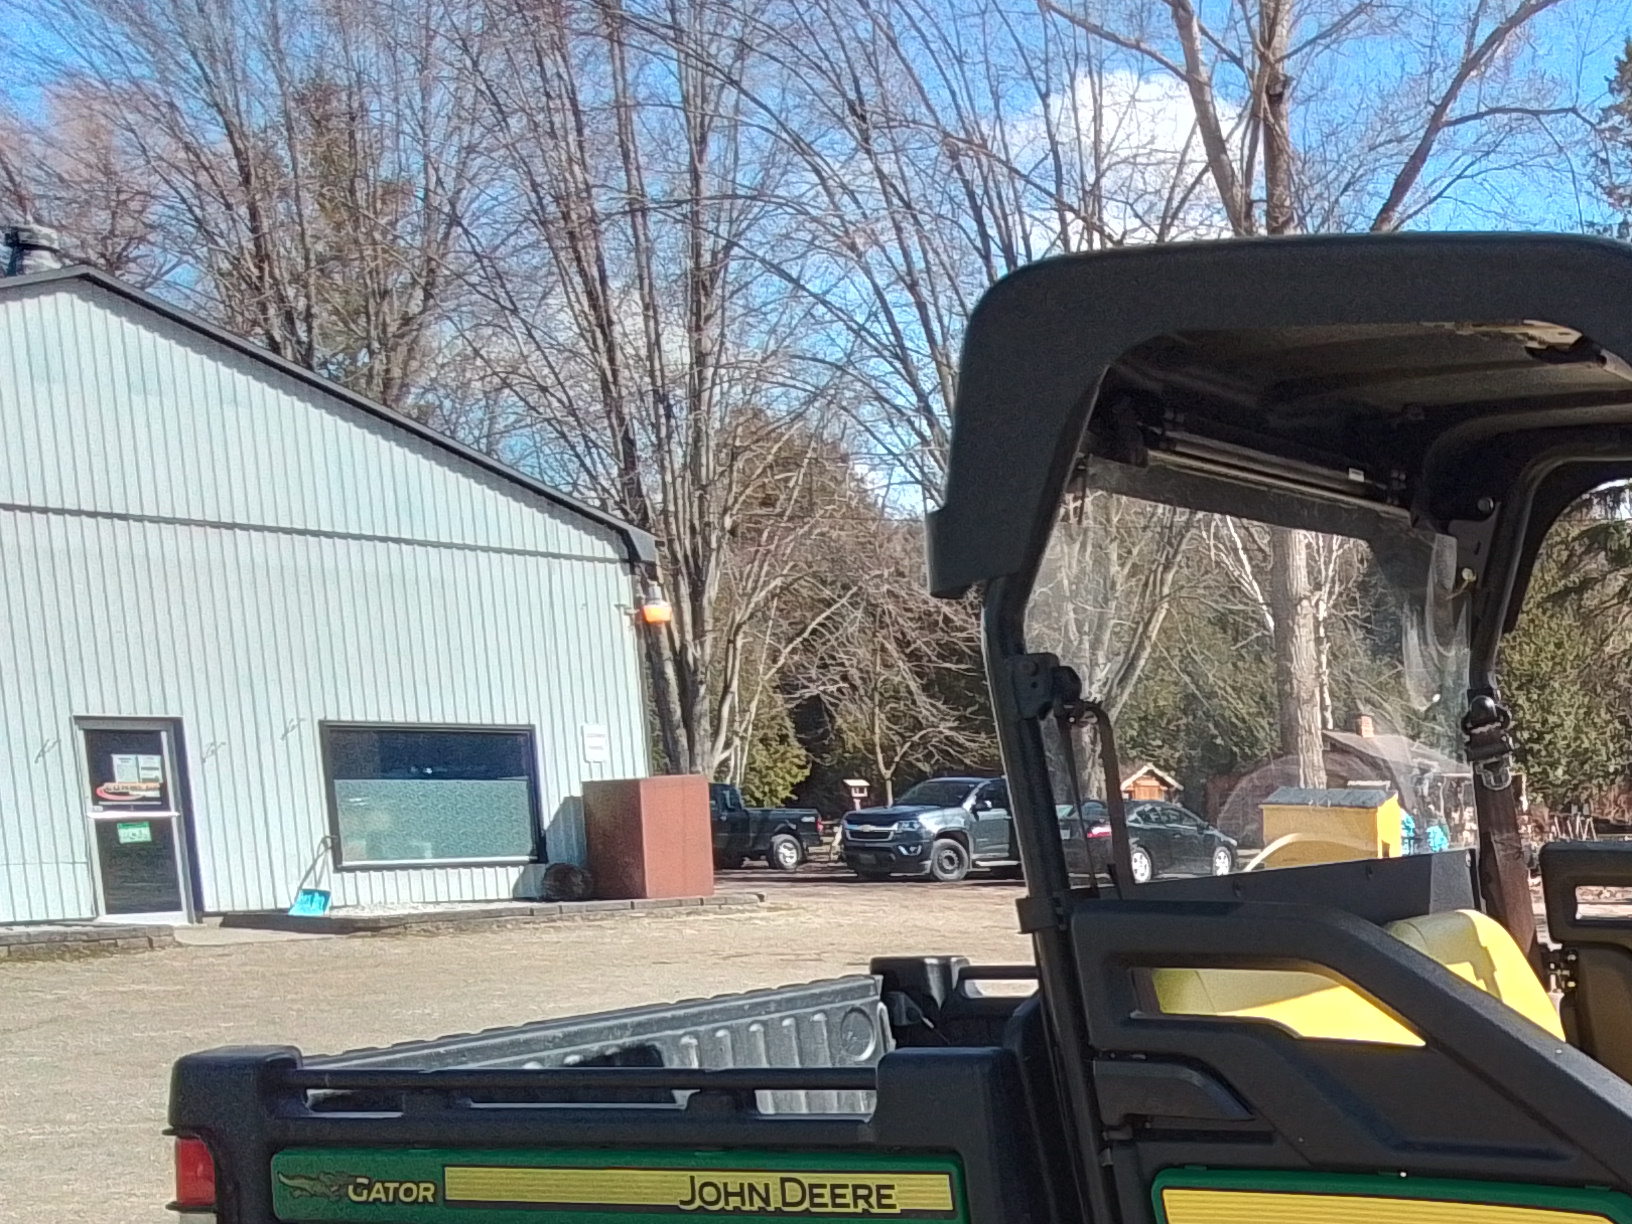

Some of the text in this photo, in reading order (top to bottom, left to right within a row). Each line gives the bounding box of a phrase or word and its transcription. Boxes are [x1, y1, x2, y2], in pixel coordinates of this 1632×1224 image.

[347, 1177, 435, 1203] GATOR
[679, 1175, 898, 1210] JOHN DEERE
